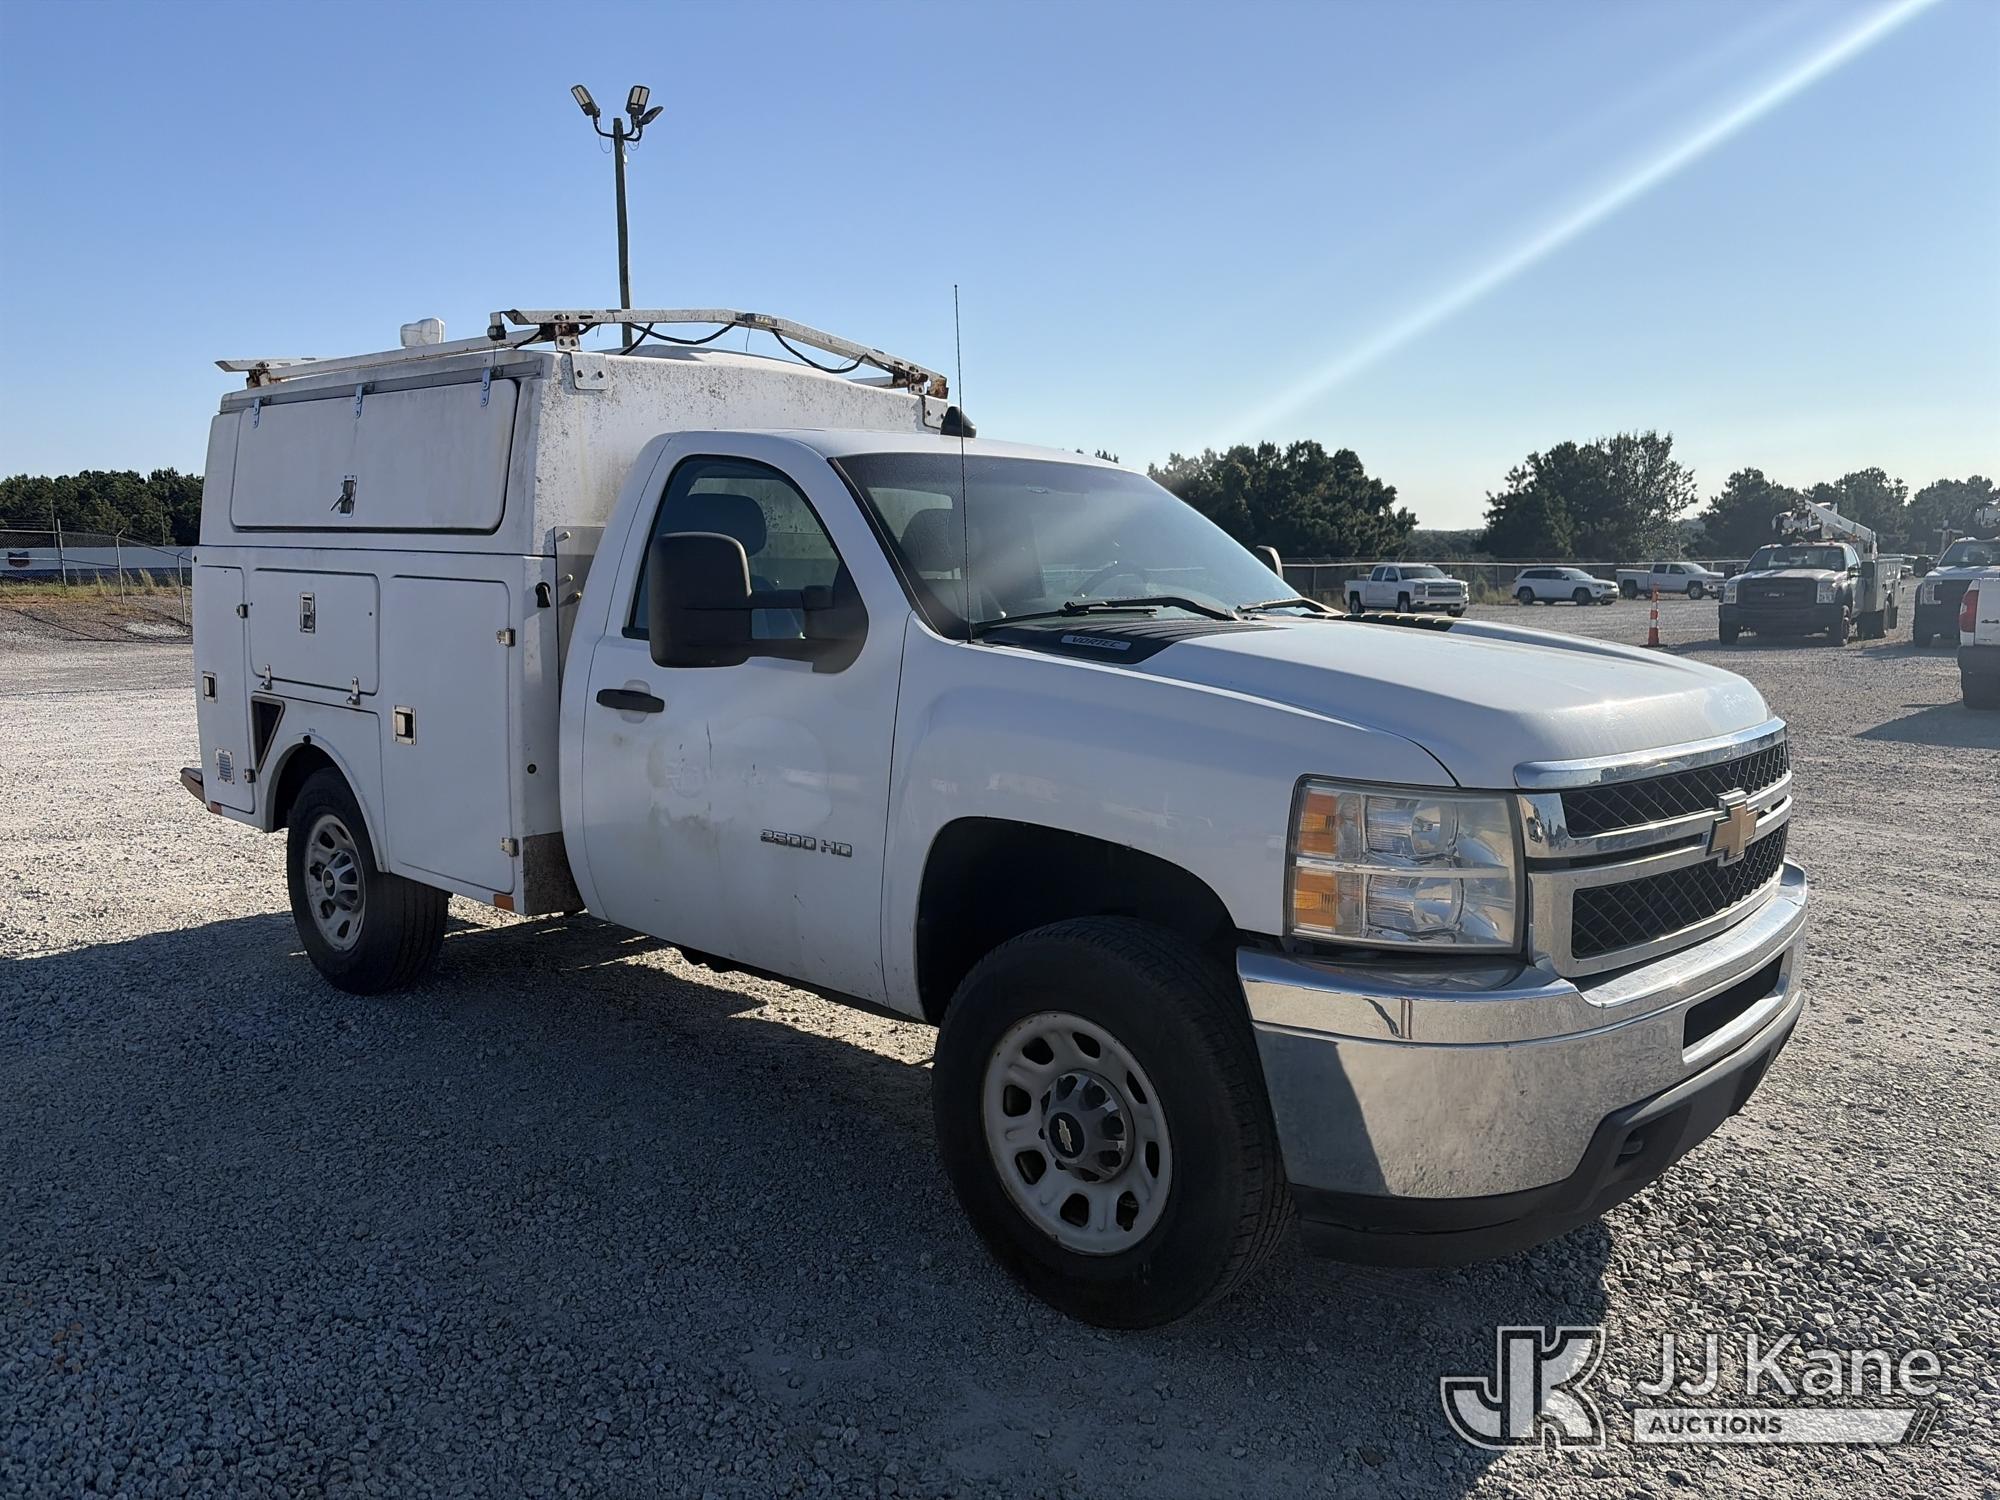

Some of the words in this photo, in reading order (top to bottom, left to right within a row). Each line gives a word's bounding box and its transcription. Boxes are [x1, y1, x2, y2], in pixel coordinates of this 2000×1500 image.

[1071, 636, 1121, 648] VORTEC
[760, 828, 817, 851] 2500
[820, 839, 853, 858] HD
